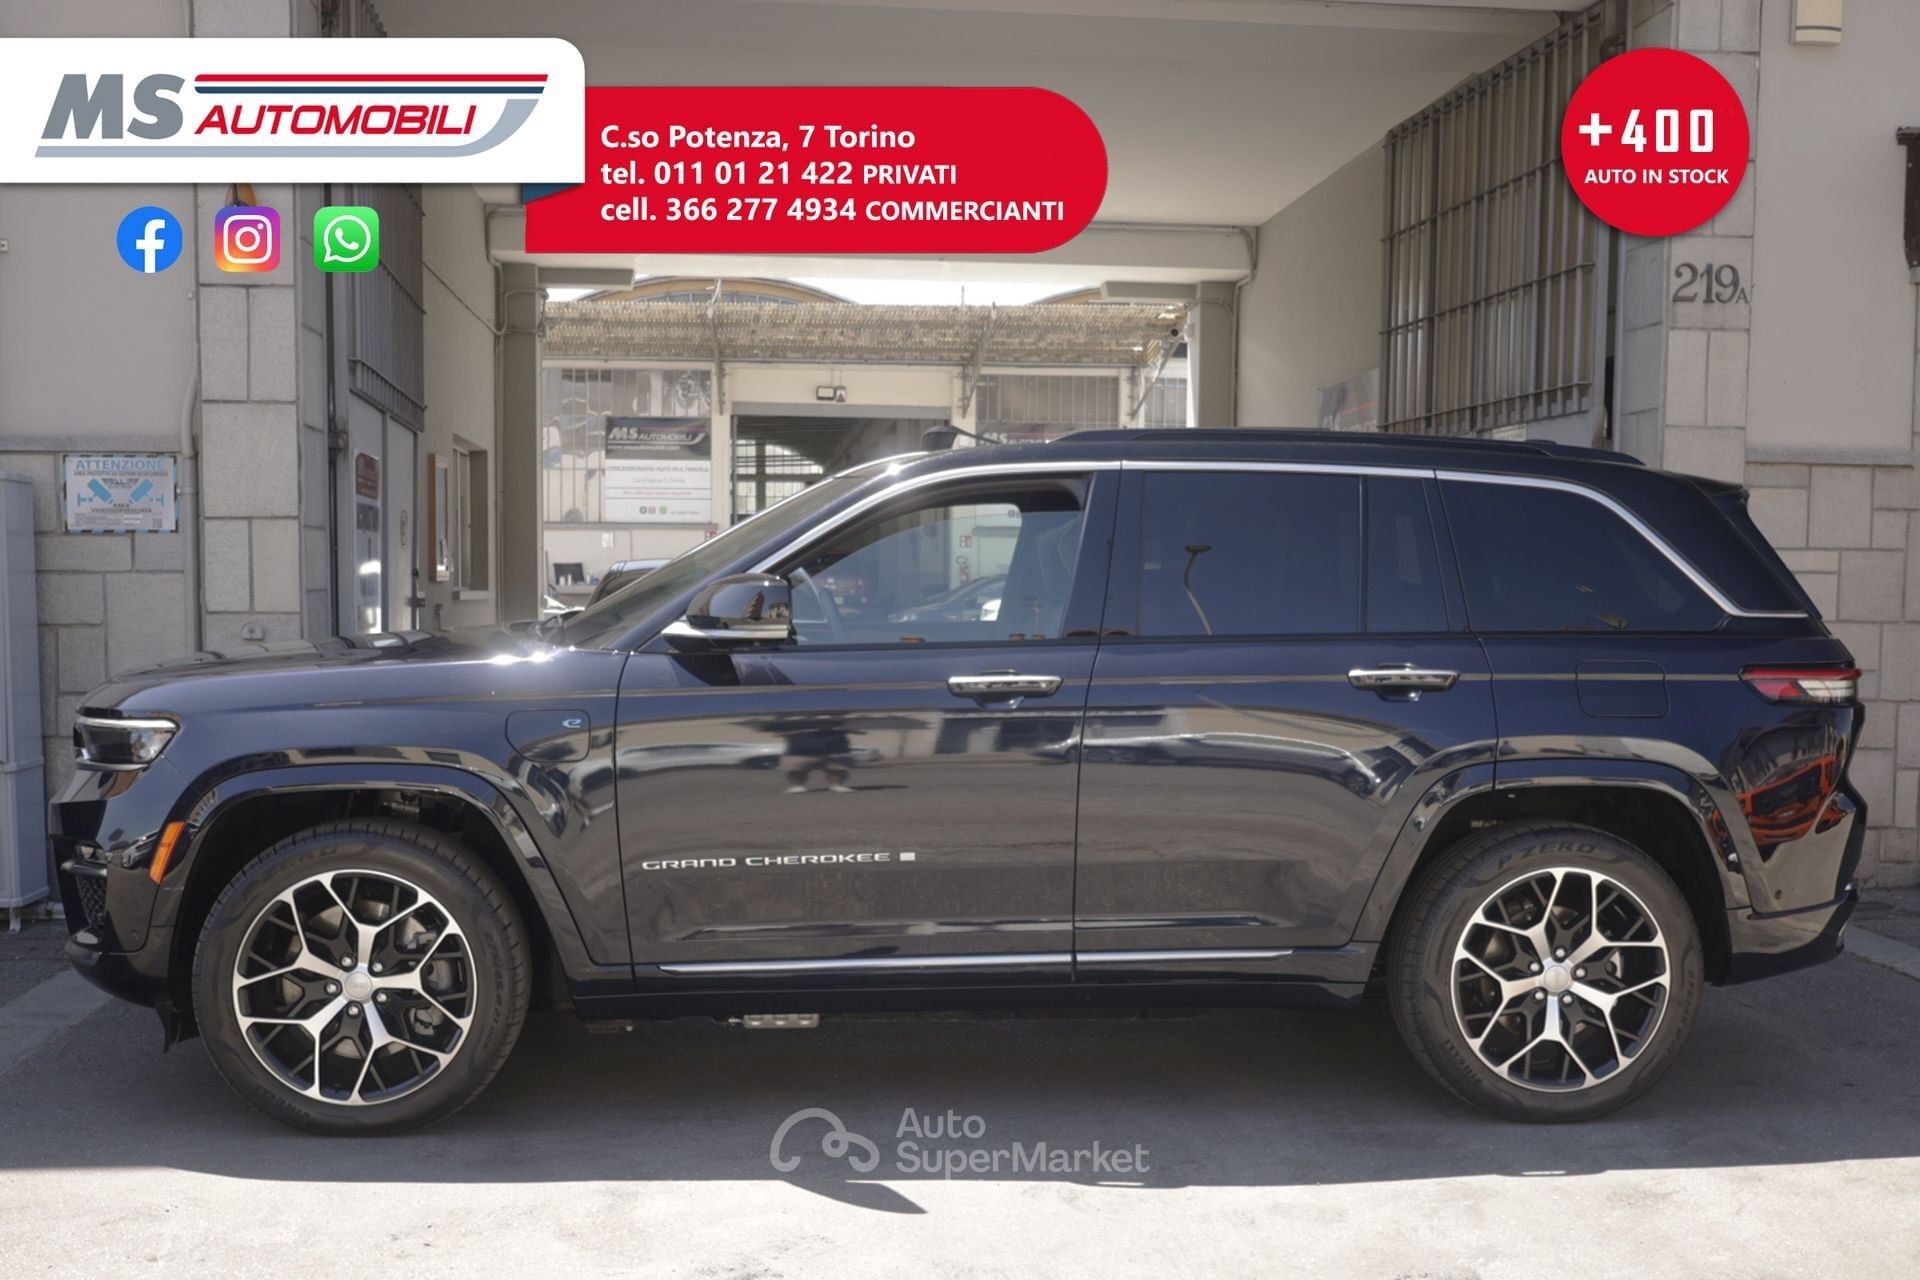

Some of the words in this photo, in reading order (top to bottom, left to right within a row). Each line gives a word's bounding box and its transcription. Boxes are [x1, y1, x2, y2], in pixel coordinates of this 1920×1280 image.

[608, 427, 639, 440] MS
[76, 459, 164, 470] ATTENZIONE
[1520, 841, 1597, 860] ZERO
[642, 858, 737, 870] GRAND
[745, 852, 891, 866] CHEROKEE
